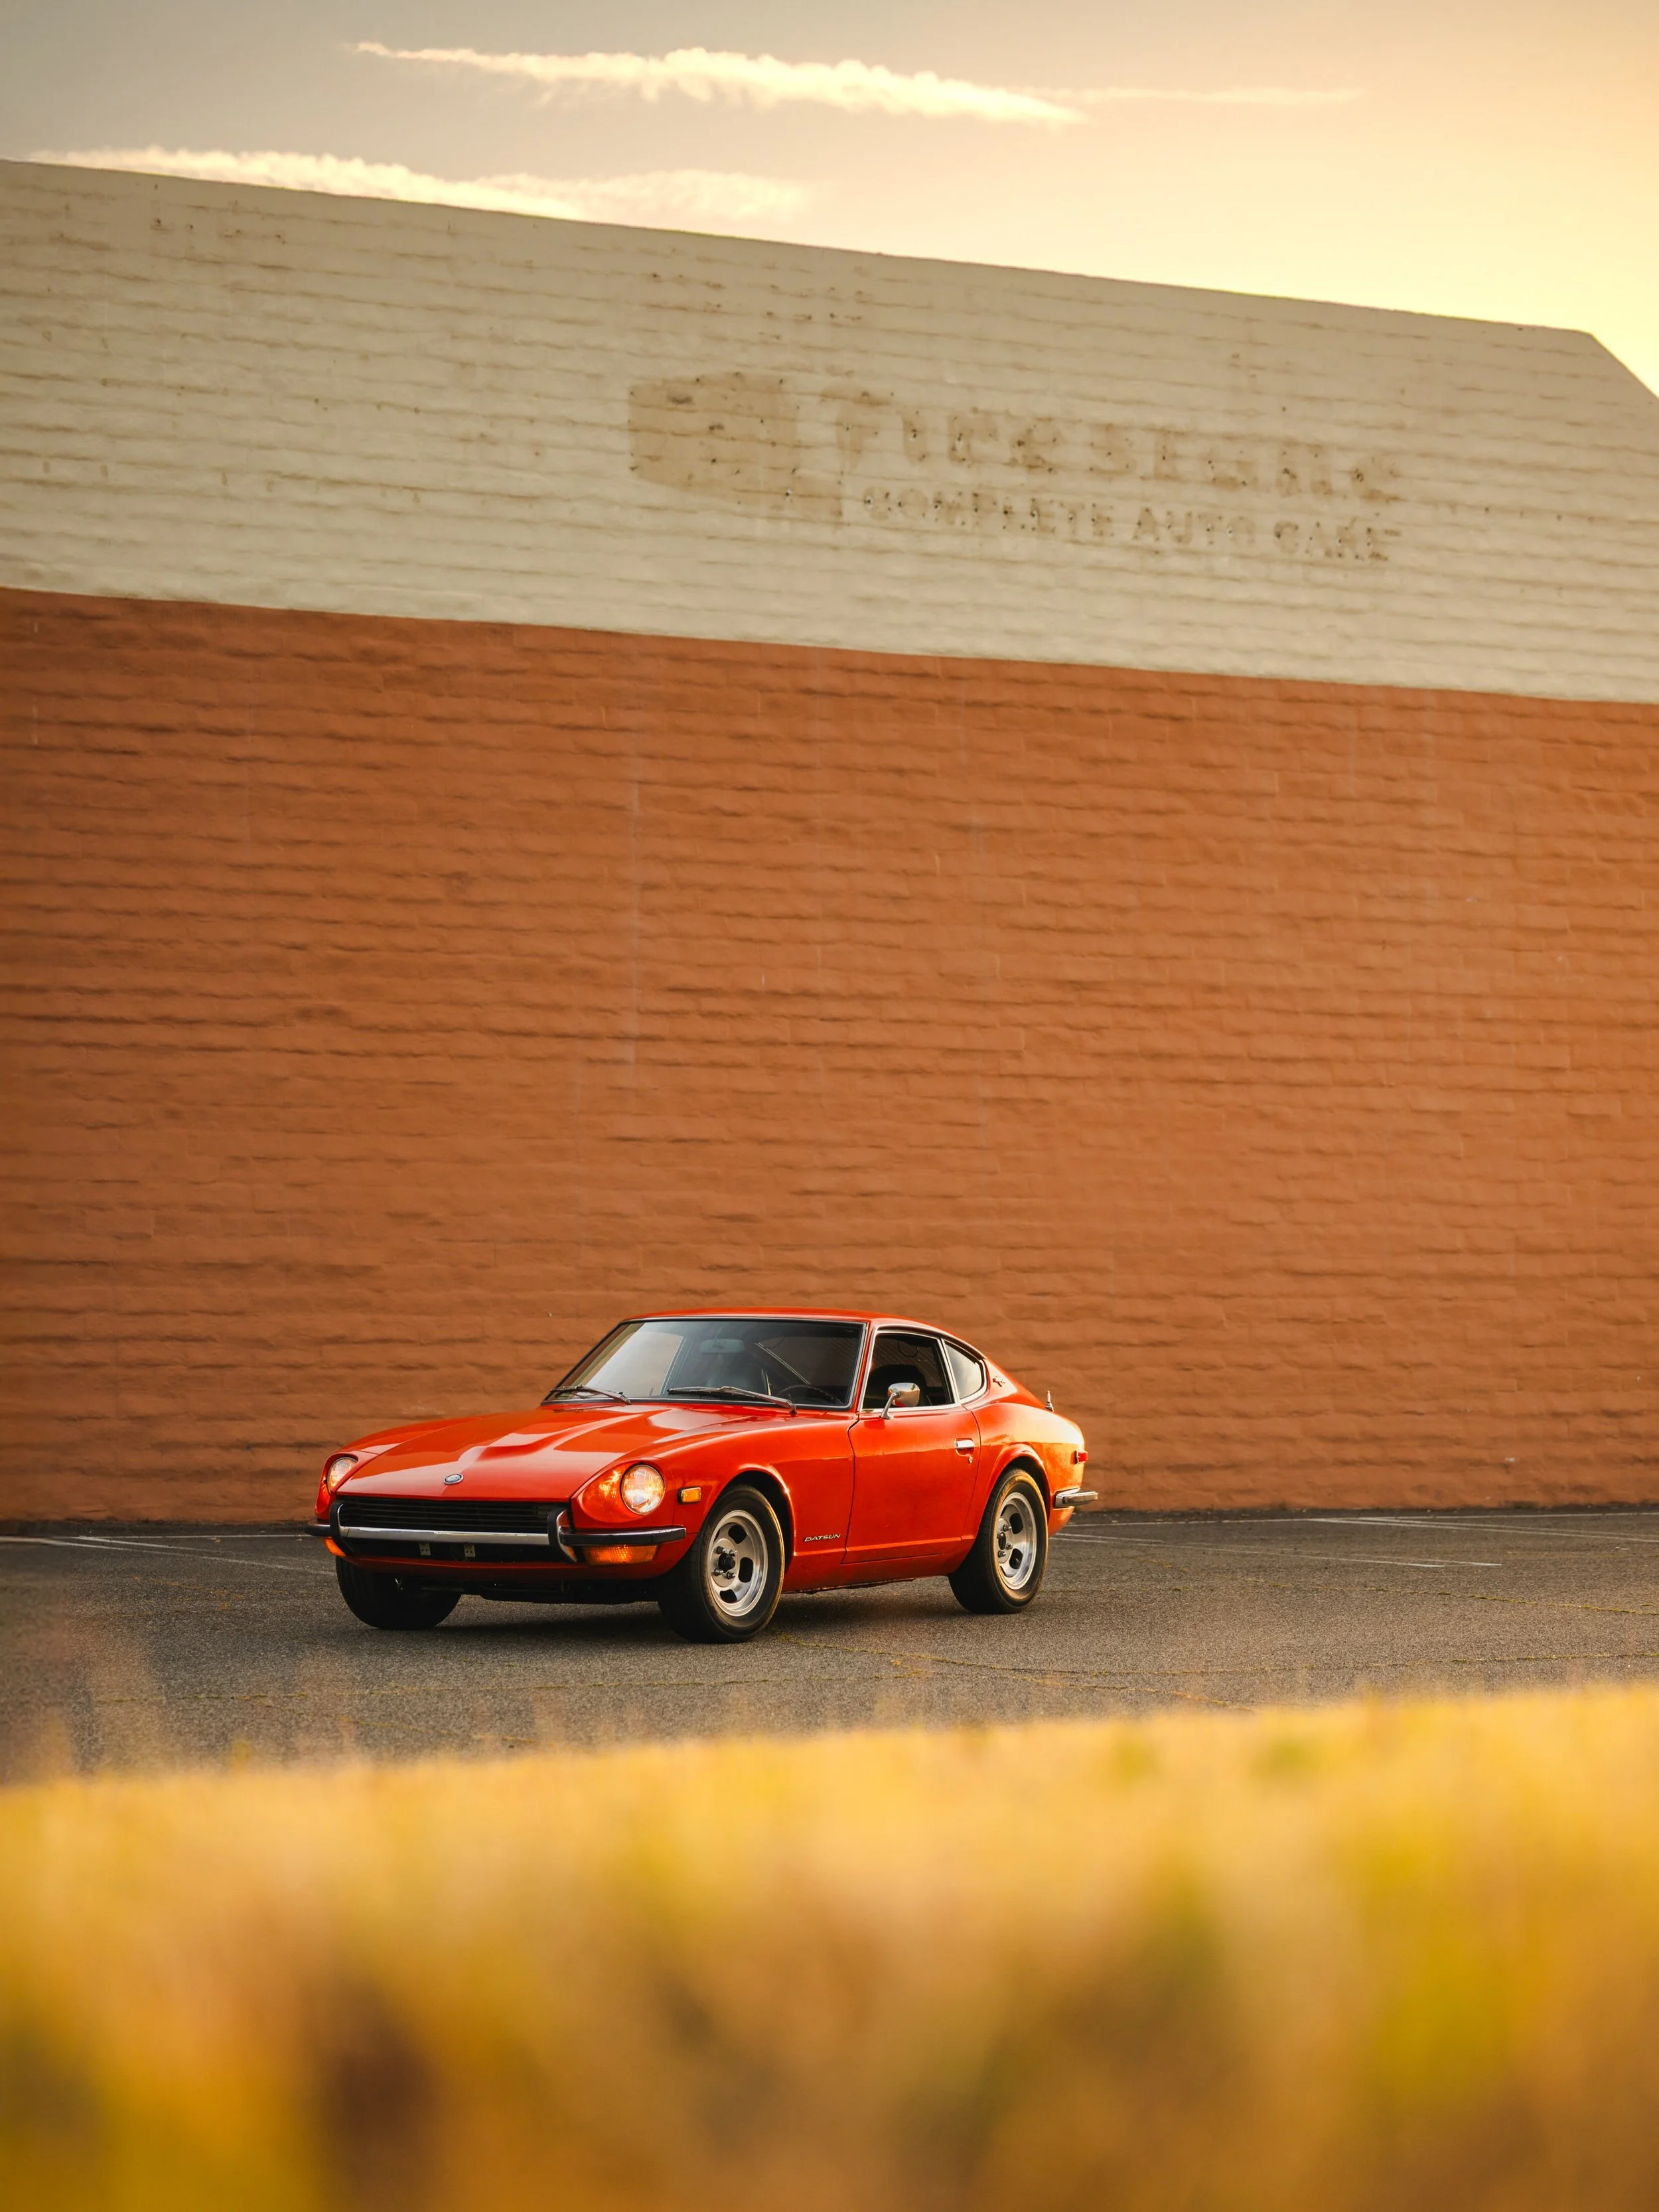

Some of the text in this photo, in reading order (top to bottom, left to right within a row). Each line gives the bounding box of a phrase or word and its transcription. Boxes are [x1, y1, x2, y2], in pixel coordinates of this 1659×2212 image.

[1132, 506, 1257, 546] AUTO
[1273, 520, 1398, 561] CARE
[804, 1533, 841, 1542] DATSUN
